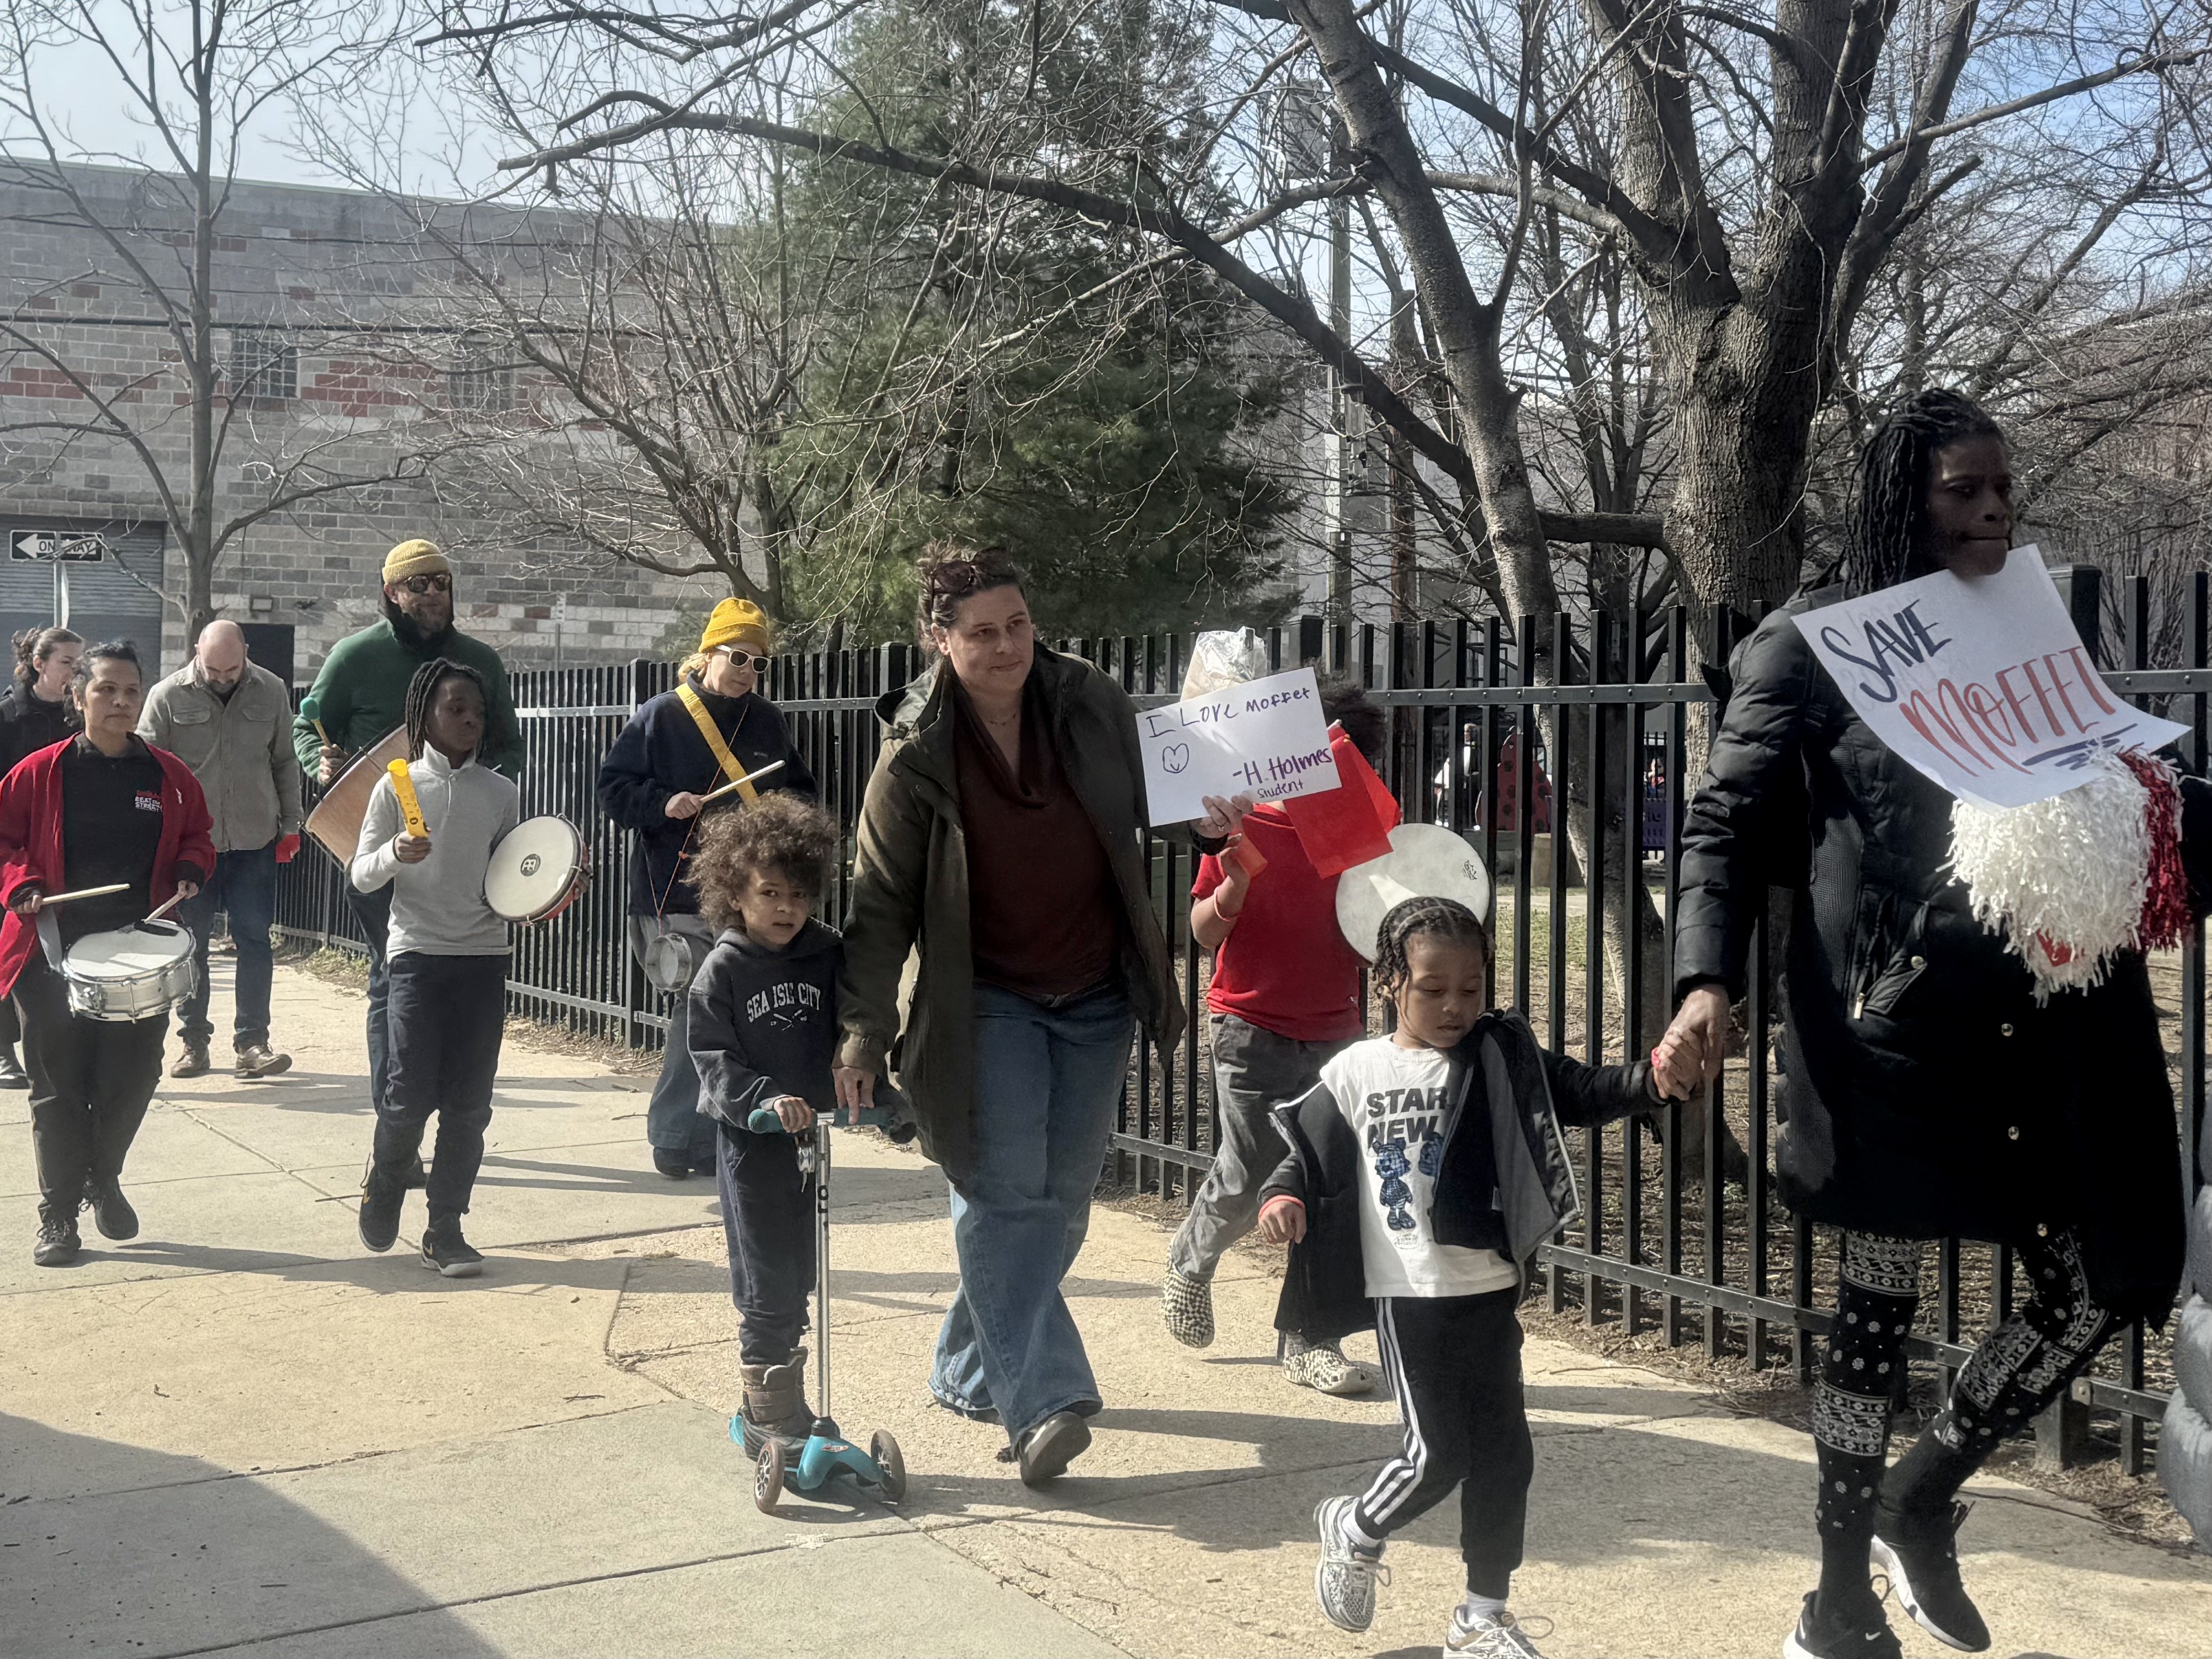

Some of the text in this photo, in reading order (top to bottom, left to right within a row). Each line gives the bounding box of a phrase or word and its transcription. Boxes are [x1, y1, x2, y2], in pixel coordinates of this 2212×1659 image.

[39, 540, 62, 552] ON
[1820, 598, 1953, 703] SAVE
[1145, 714, 1176, 738] I
[1899, 645, 2116, 777] MOFFET
[1268, 747, 1332, 781] Holmes
[746, 982, 821, 1023] SEA ISLE CITY
[1366, 1086, 1448, 1118] STAR
[1367, 1115, 1439, 1150] NEW
